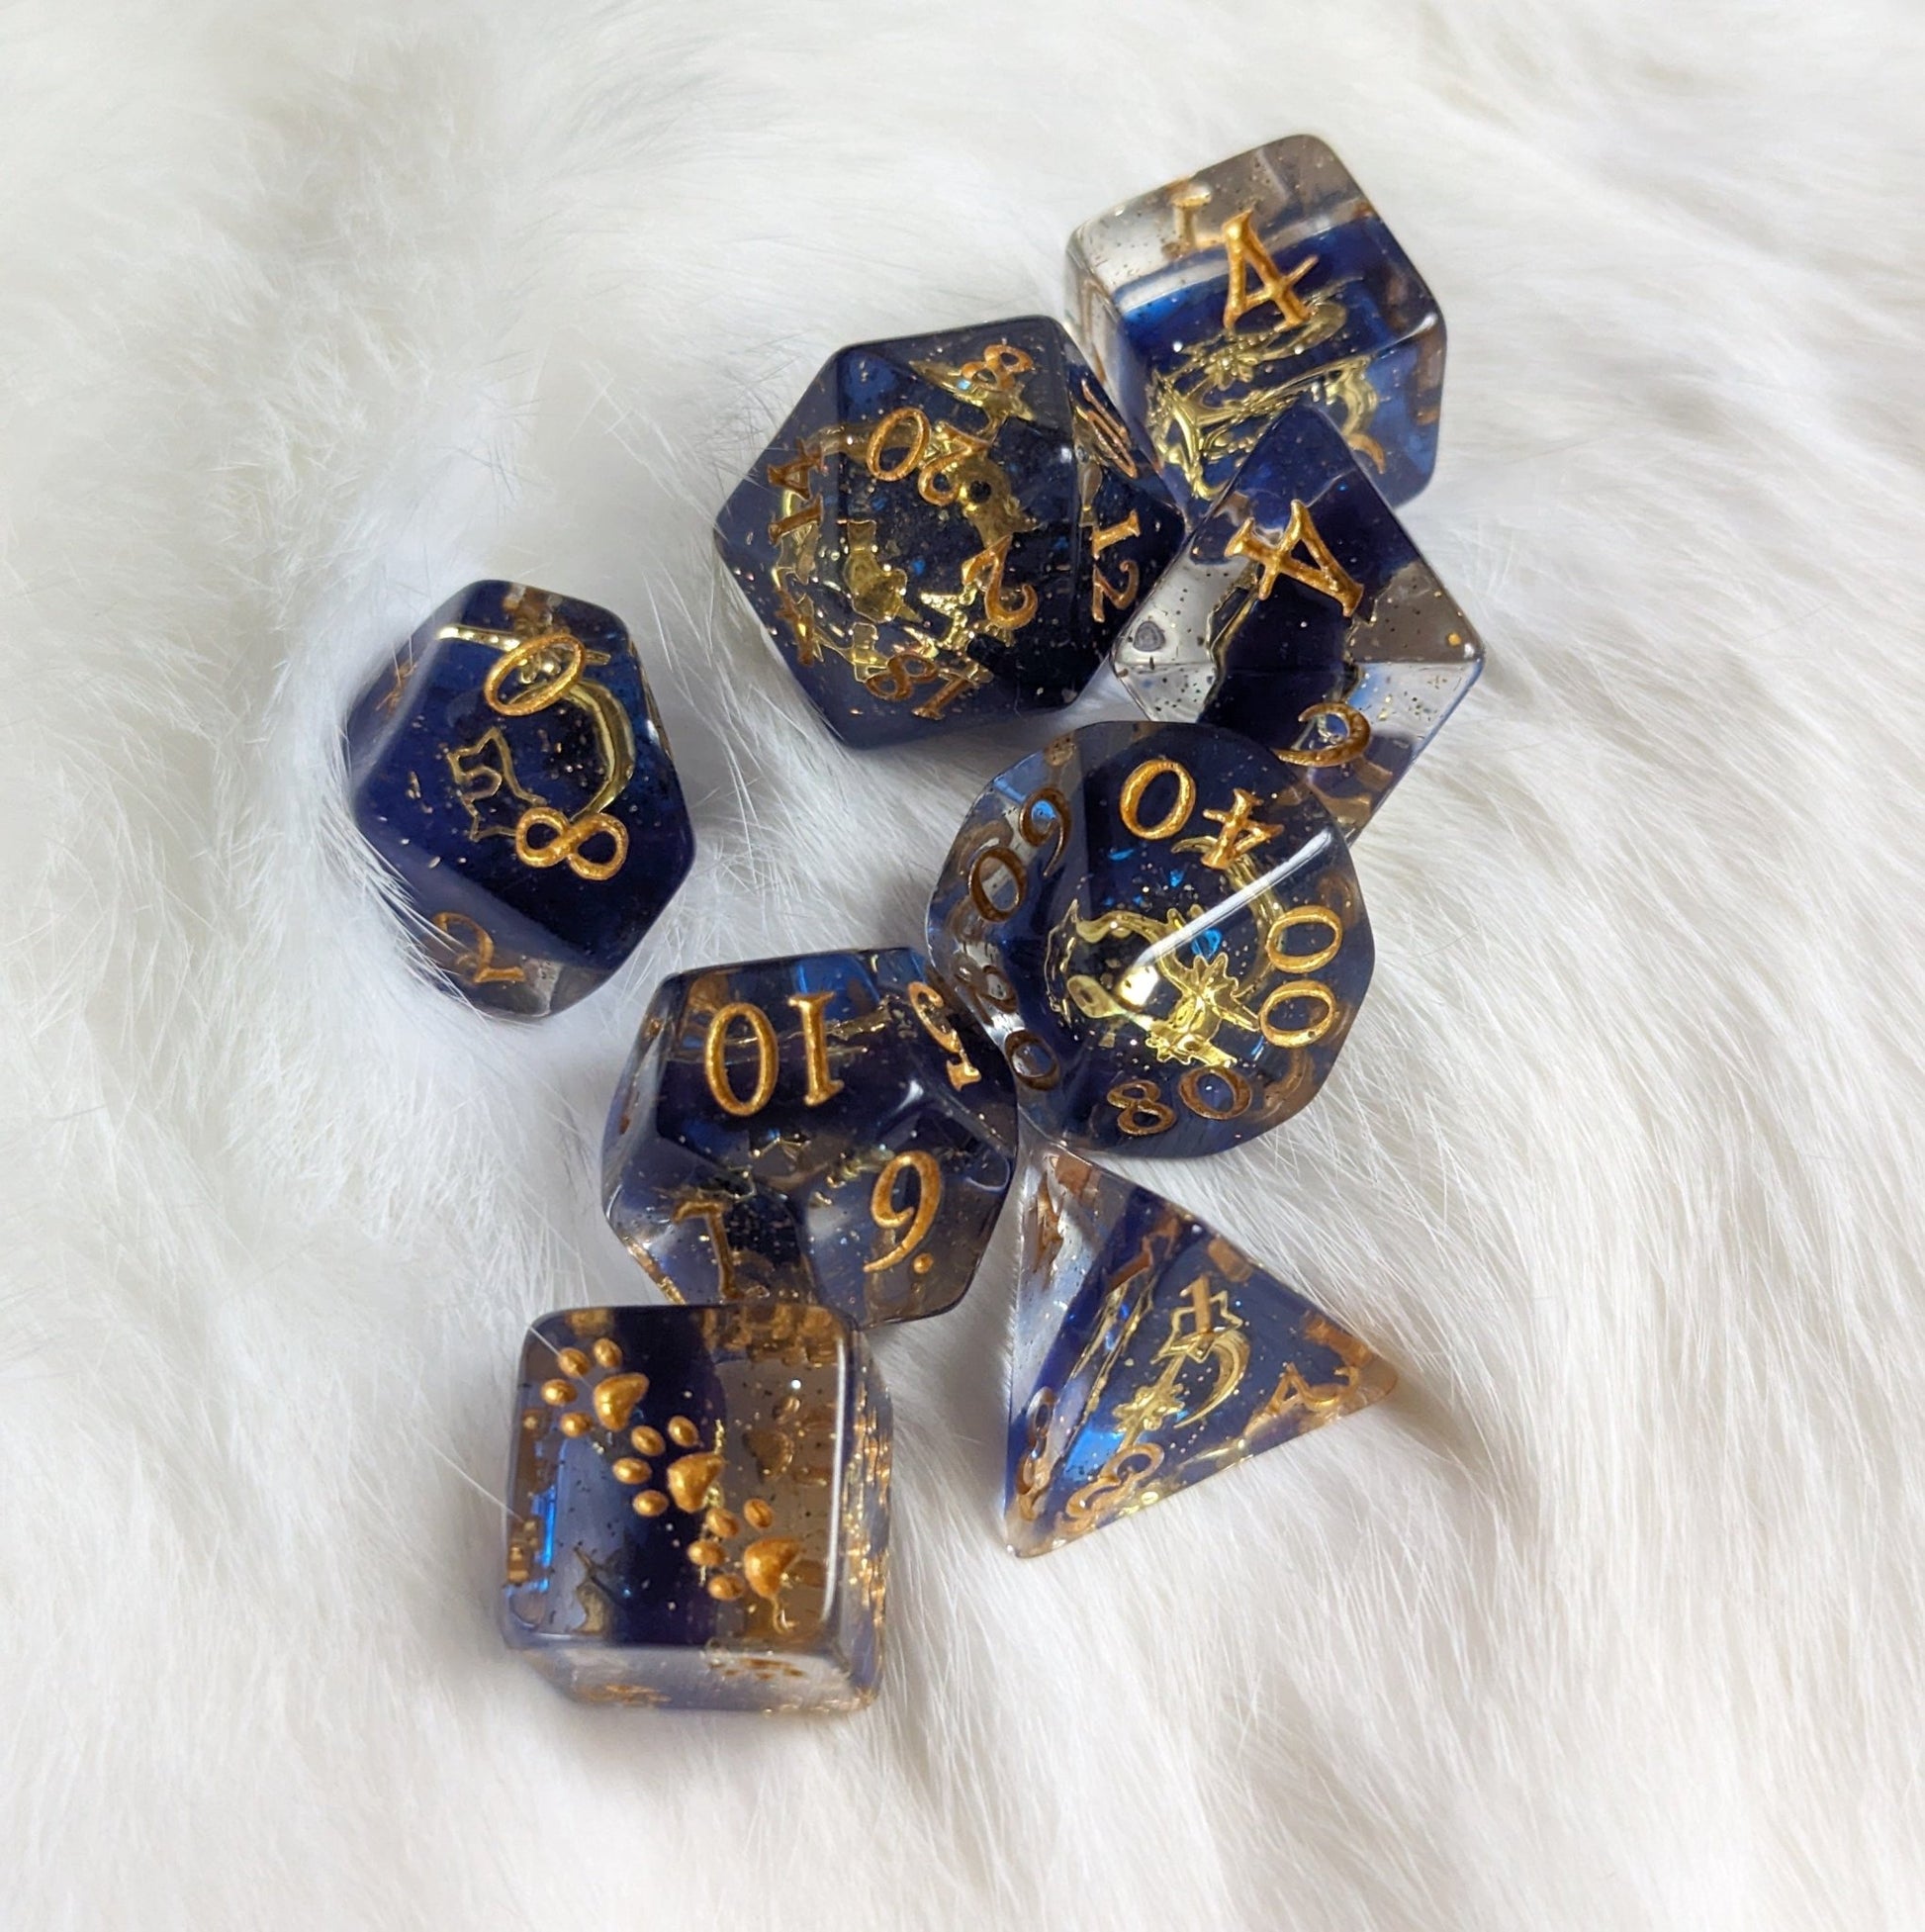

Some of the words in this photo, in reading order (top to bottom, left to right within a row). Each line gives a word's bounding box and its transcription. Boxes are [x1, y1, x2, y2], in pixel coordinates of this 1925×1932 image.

[867, 407, 990, 506] 20
[962, 534, 1039, 630] 2
[1091, 509, 1141, 623] 12
[1224, 500, 1364, 618] 4
[485, 632, 586, 716] 0
[515, 806, 628, 880] 8
[1120, 759, 1284, 871] 40
[1257, 905, 1343, 1049] 00
[704, 991, 845, 1118] 10
[1107, 1063, 1253, 1137] 80
